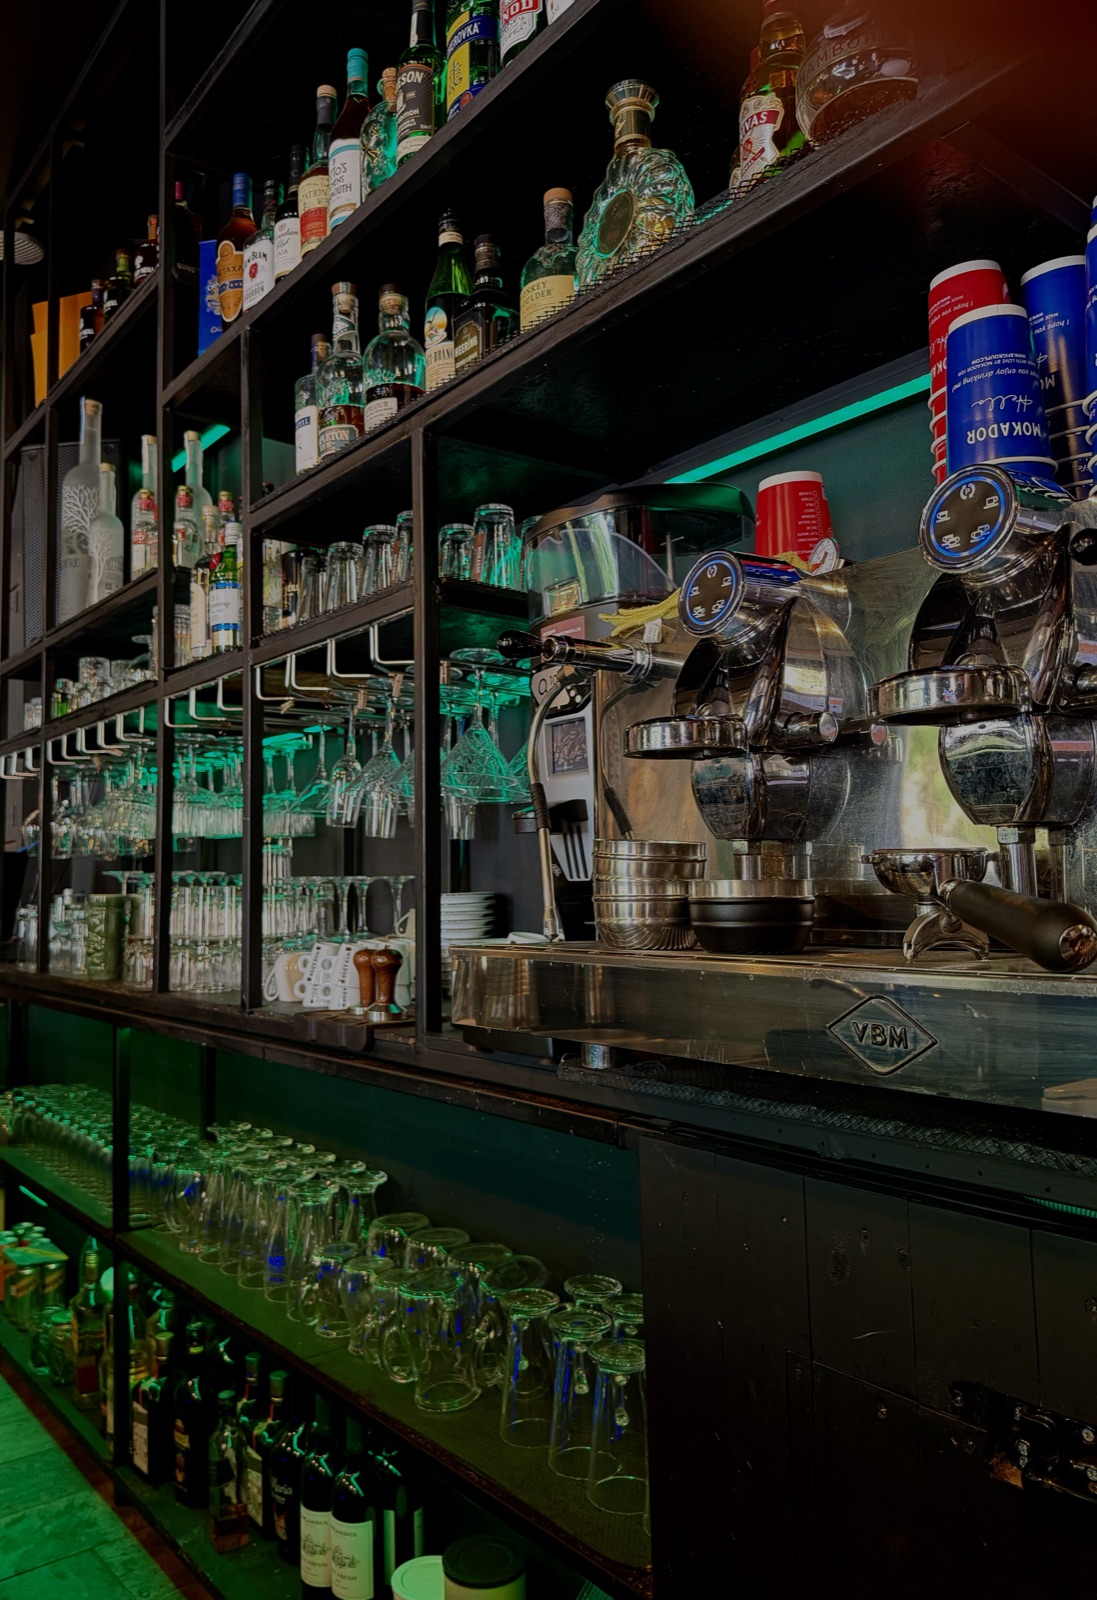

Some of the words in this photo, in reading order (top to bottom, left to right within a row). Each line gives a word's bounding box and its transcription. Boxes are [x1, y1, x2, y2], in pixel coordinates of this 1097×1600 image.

[1047, 321, 1065, 331] hope
[962, 370, 994, 383] drinking
[995, 367, 1017, 376] enjoy
[971, 394, 1034, 413] Hello
[966, 421, 1042, 445] MOKADOR
[851, 1020, 909, 1050] VBM
